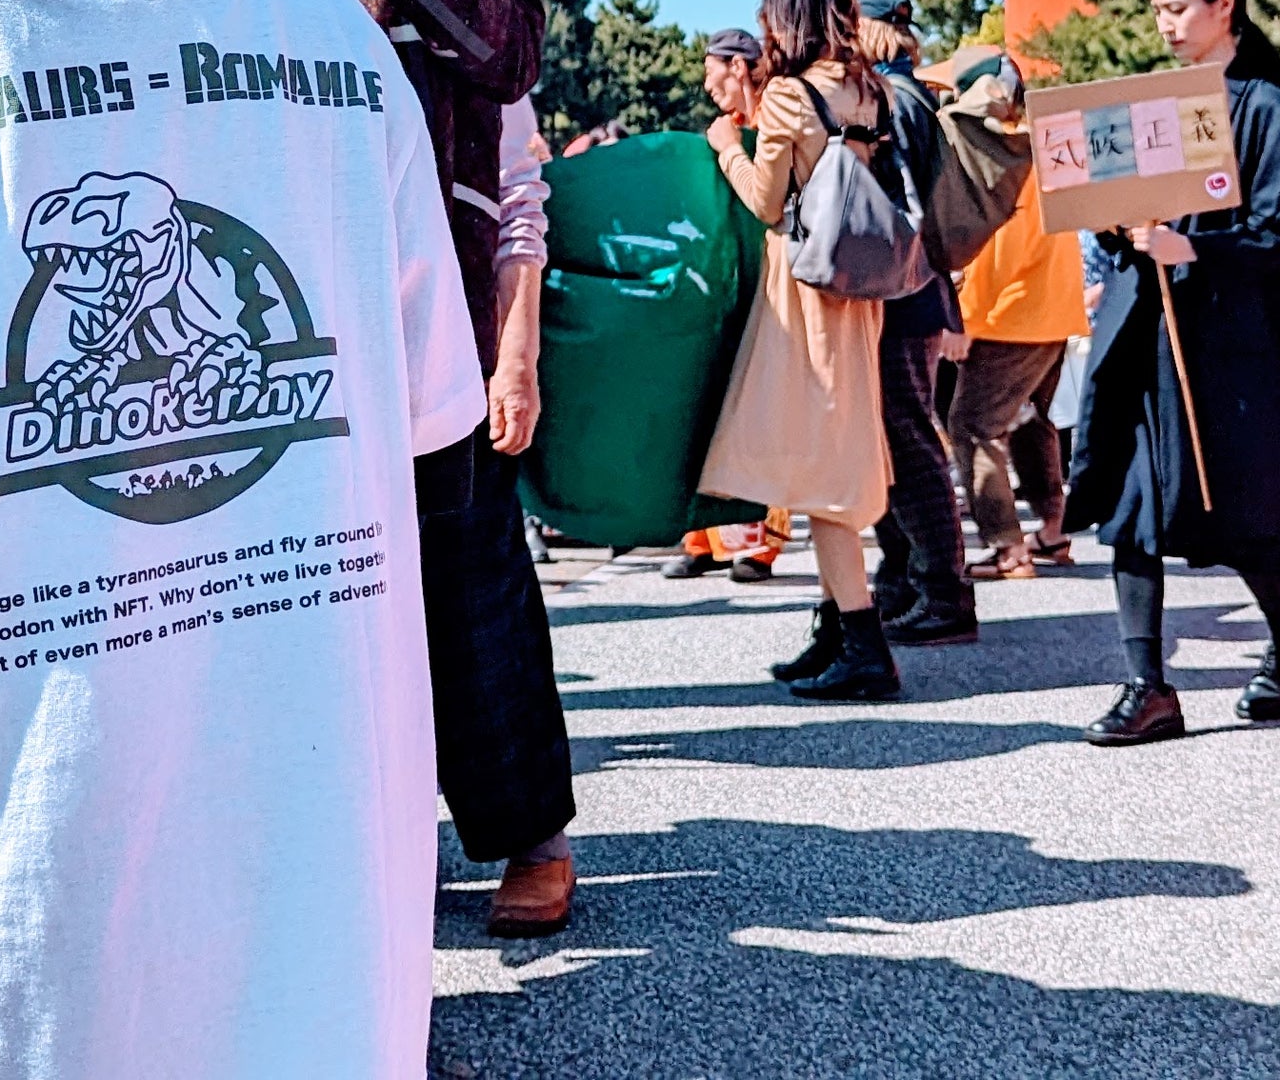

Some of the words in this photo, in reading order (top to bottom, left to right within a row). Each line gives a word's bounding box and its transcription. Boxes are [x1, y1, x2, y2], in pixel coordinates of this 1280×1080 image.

[32, 583, 72, 604] like
[77, 581, 91, 594] a
[95, 550, 228, 592] tyrannosaurus
[234, 540, 274, 561] and
[280, 536, 307, 553] fly
[314, 523, 375, 548] around
[61, 606, 108, 629] with
[113, 596, 154, 619] NFT.
[159, 587, 195, 609] Why
[199, 573, 254, 597] don't
[260, 569, 289, 584] we
[295, 563, 332, 581] live
[14, 649, 38, 669] of
[45, 642, 99, 663] even
[105, 629, 153, 652] more
[158, 624, 168, 639] a
[172, 609, 224, 635] man's
[232, 598, 293, 620] sense
[299, 590, 322, 608] of
